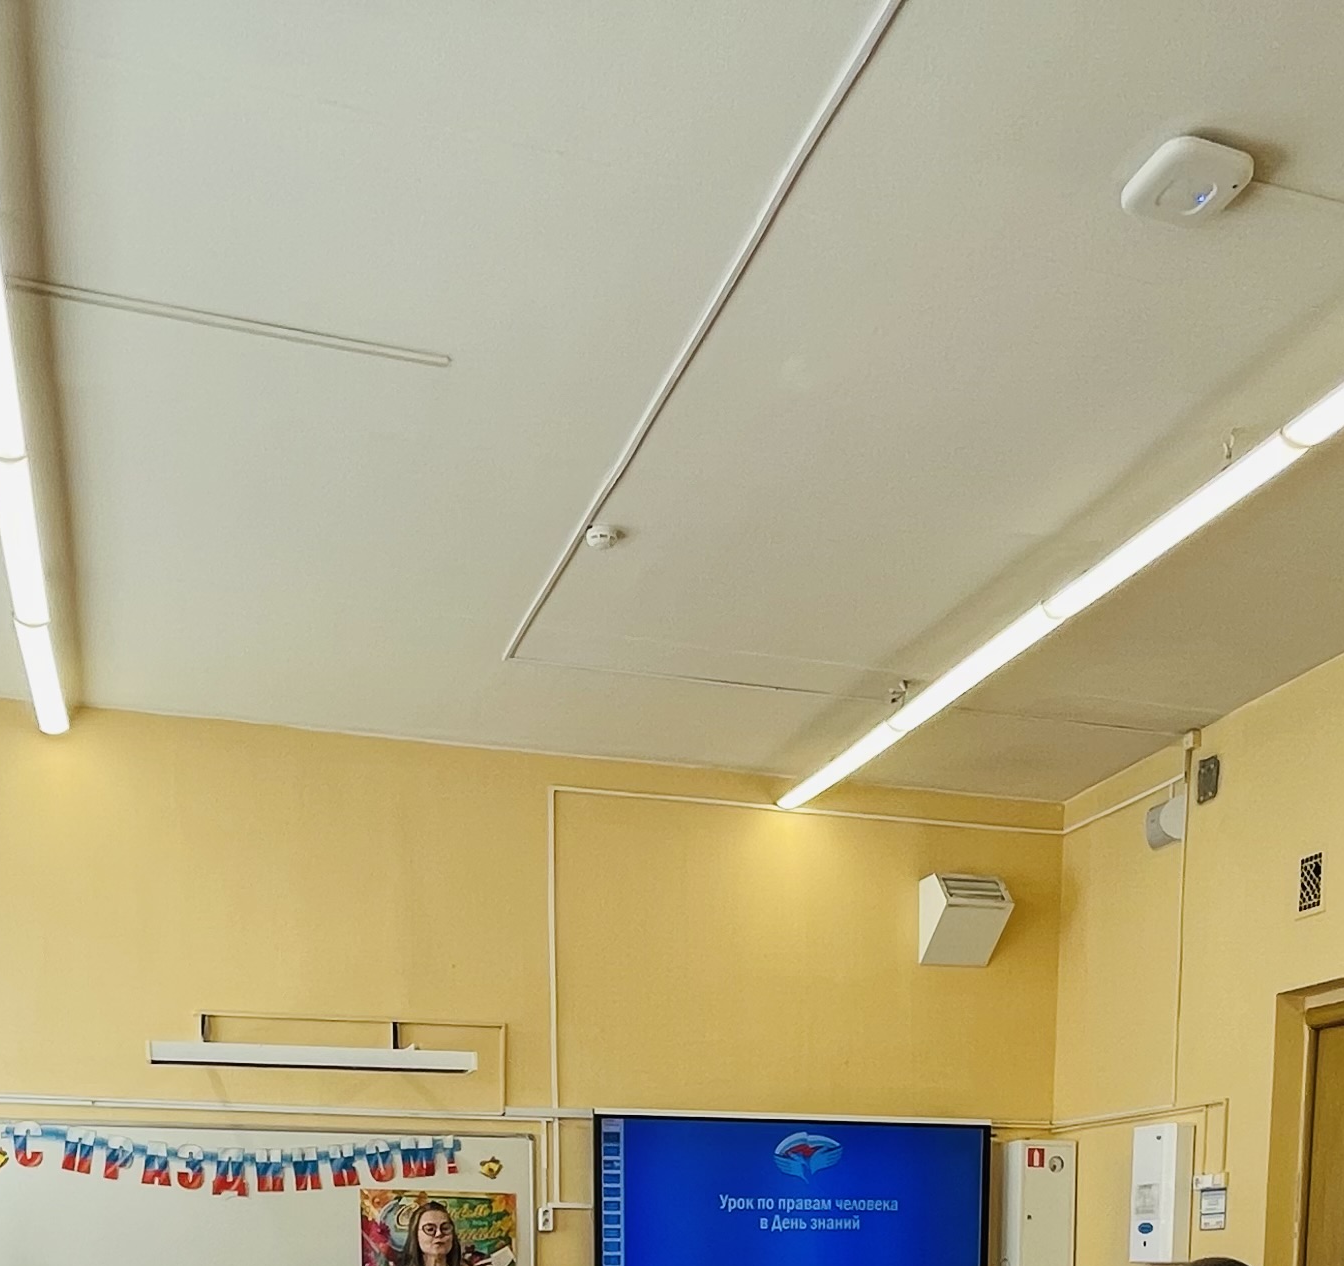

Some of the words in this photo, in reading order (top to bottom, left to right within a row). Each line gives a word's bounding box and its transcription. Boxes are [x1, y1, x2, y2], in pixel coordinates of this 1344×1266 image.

[12, 1120, 44, 1168] С
[61, 1125, 460, 1198] ПРАЗДНИКОМ!
[719, 1194, 754, 1212] Урок
[757, 1197, 774, 1210] по
[778, 1197, 831, 1213] правам
[835, 1198, 898, 1211] человека
[760, 1217, 768, 1230] в
[770, 1214, 807, 1232] День
[810, 1215, 860, 1230] знаний
